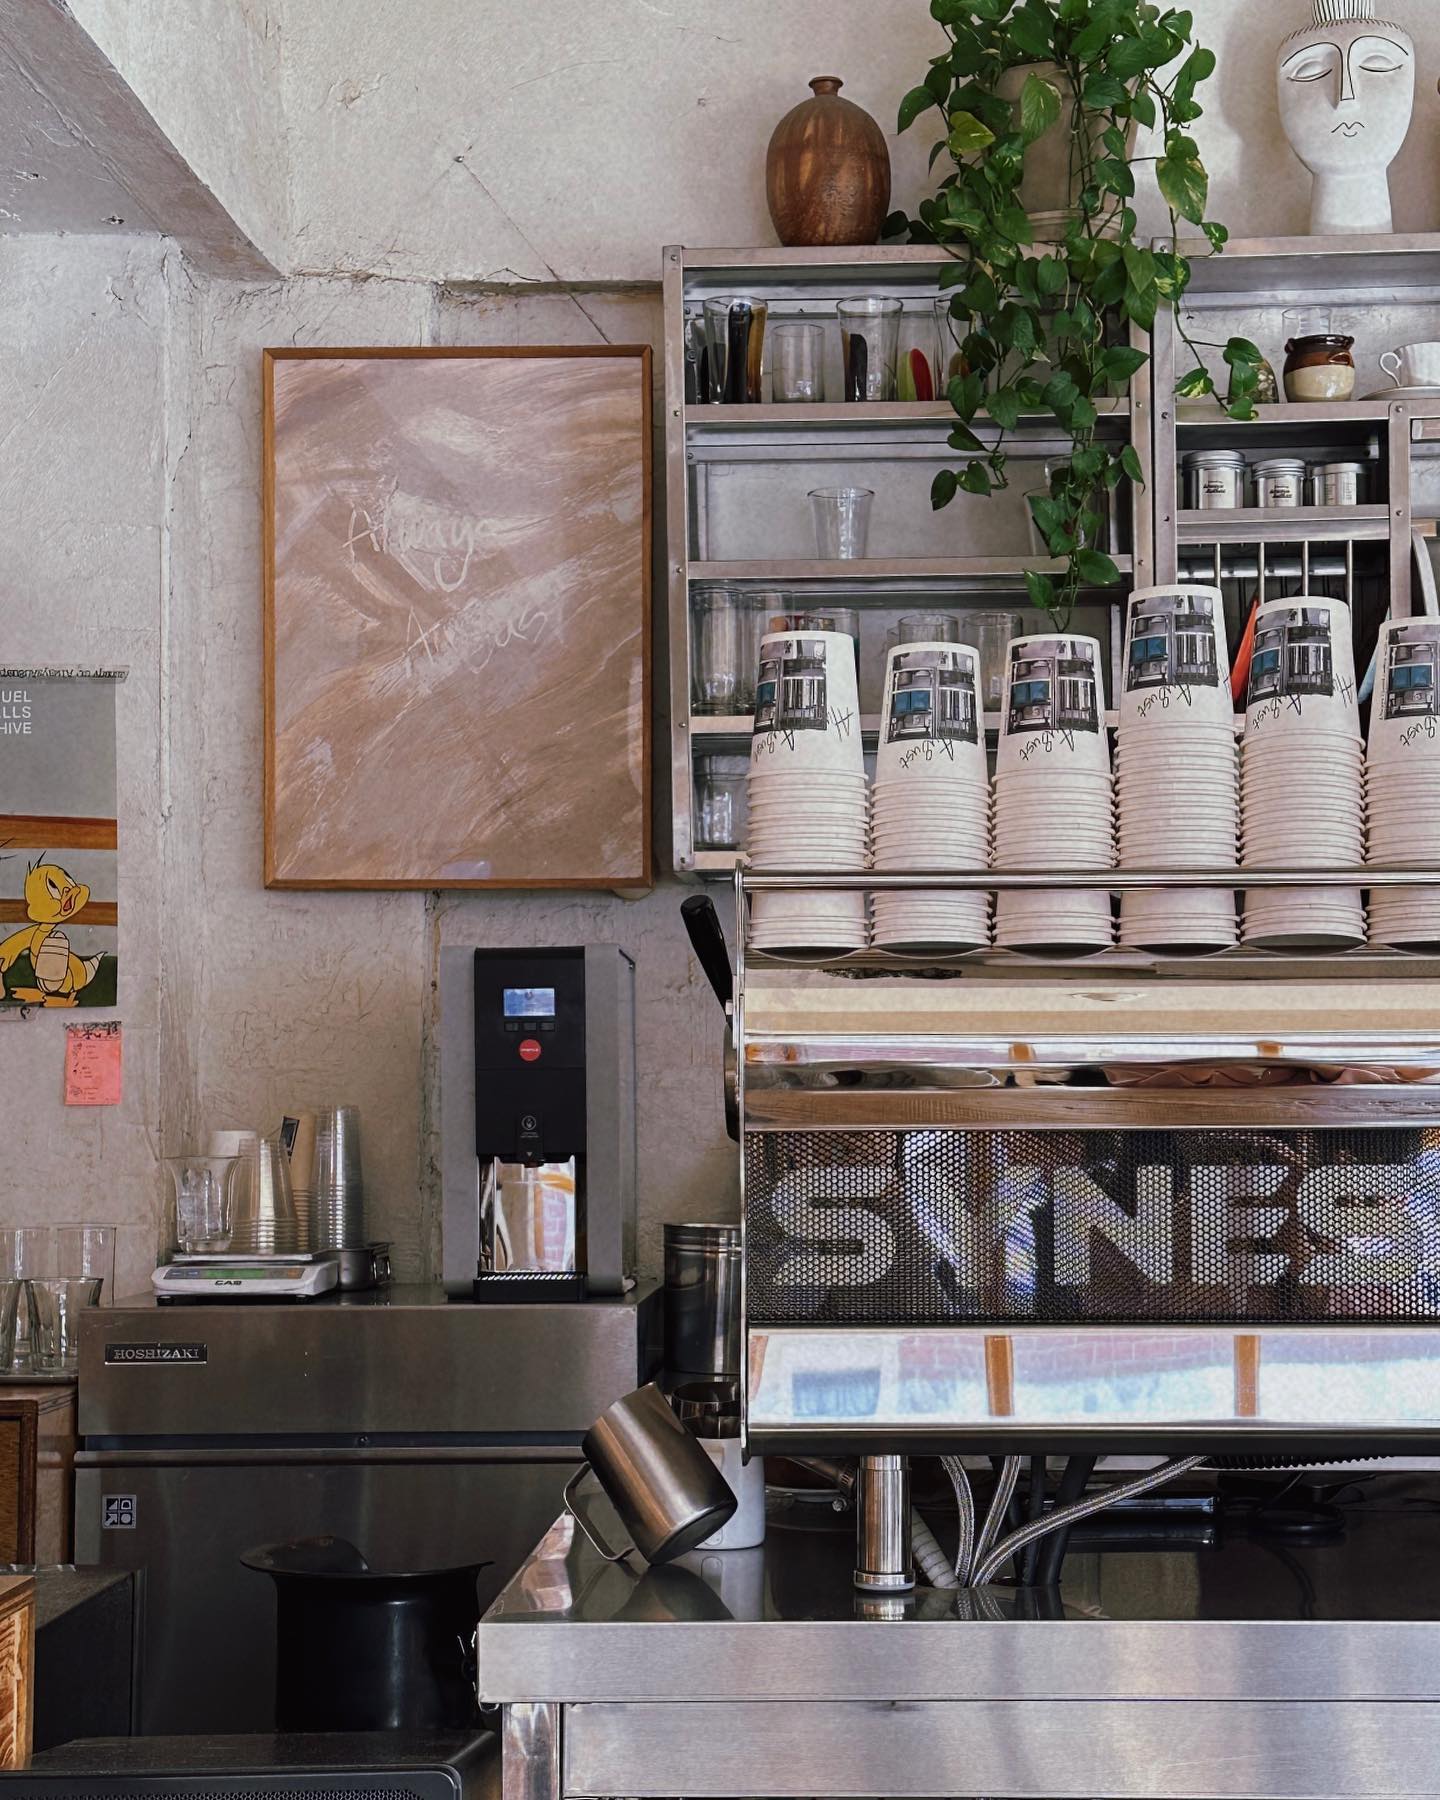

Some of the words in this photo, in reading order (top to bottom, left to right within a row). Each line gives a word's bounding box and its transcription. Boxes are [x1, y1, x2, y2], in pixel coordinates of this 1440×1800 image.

[1, 690, 32, 702] UEL
[0, 705, 31, 719] LLS
[1399, 714, 1440, 747] gust
[113, 1348, 200, 1360] HOSHIZAKI
